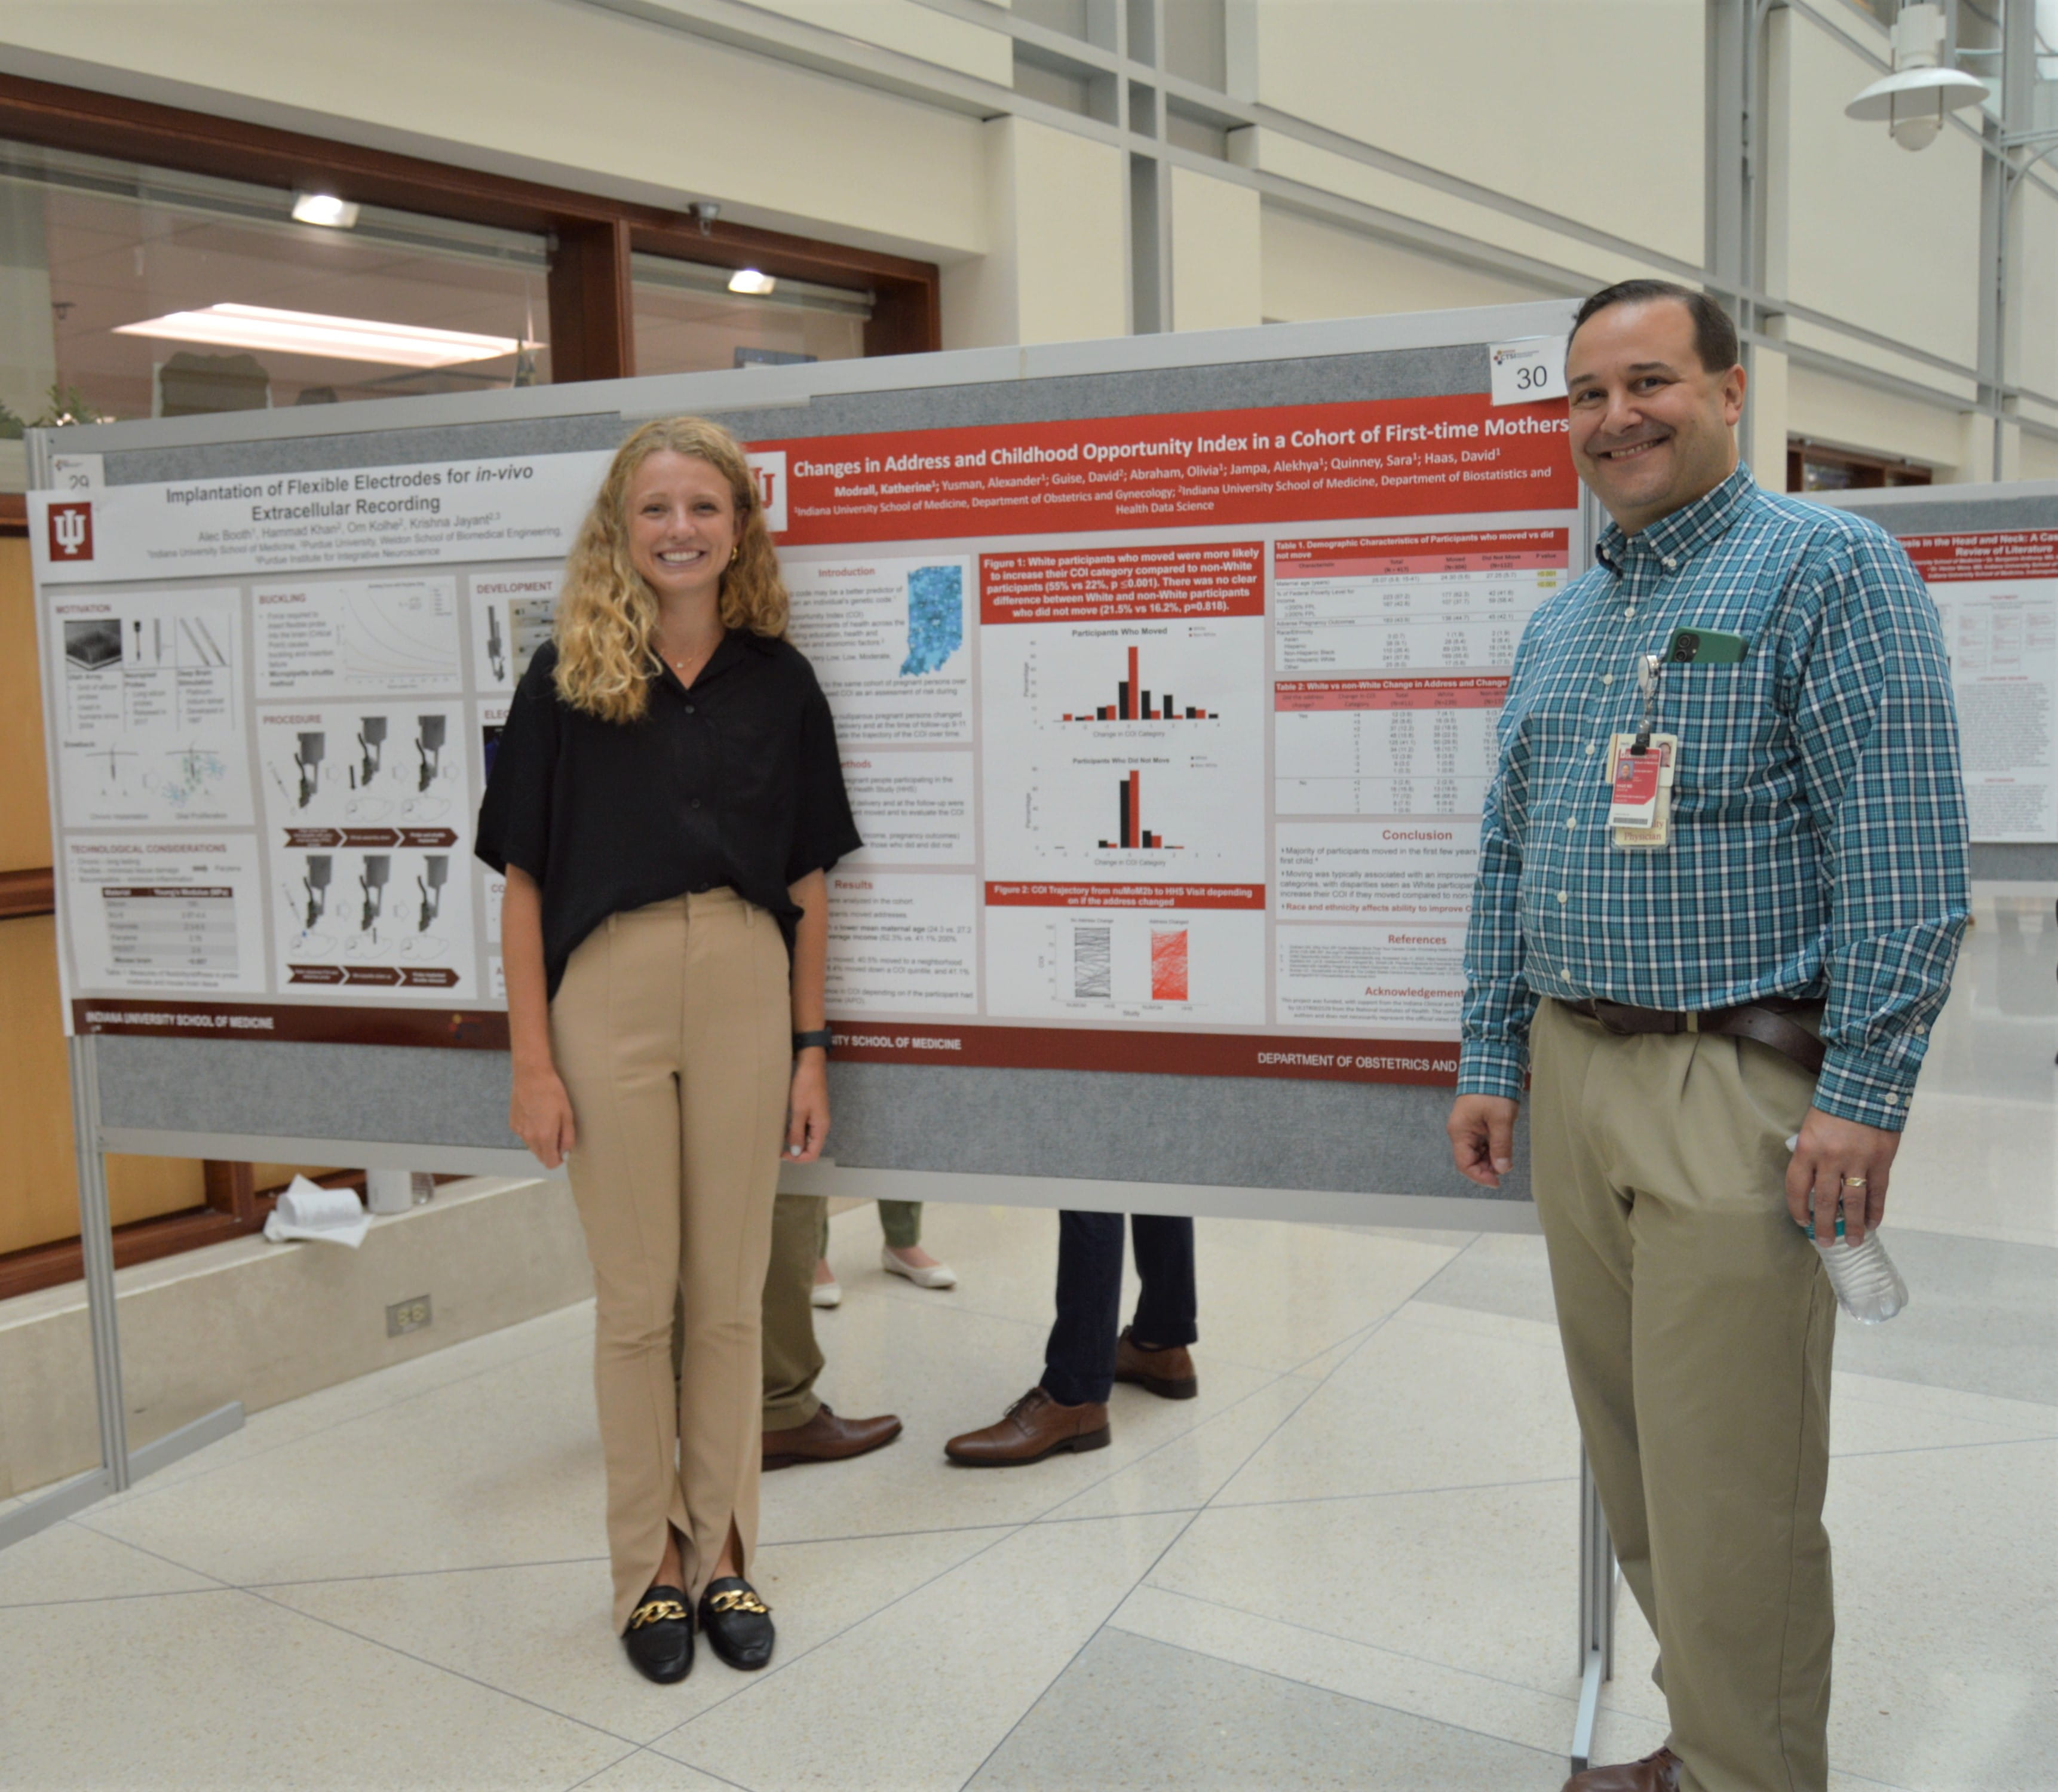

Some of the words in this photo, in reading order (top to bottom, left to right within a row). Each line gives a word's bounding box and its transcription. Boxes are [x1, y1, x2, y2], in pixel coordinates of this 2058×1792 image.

[1517, 366, 1547, 389] 30
[794, 461, 861, 478] Changes
[865, 457, 881, 472] in
[885, 455, 950, 471] Address
[955, 450, 986, 467] and
[990, 445, 1078, 465] Childhood
[1083, 440, 1192, 461] Opportunity
[1198, 435, 1247, 452] Index
[1253, 433, 1269, 449] in
[1275, 435, 1285, 449] a
[1291, 429, 1355, 447] Cohort
[1361, 425, 1381, 443] of
[1386, 422, 1479, 441] First-time
[1485, 416, 1572, 435] Mothers
[835, 484, 878, 497] Modrall,
[941, 480, 985, 490] Yusman,
[1051, 473, 1085, 484] Guise,
[1130, 468, 1184, 480] Abraham,
[1230, 464, 1270, 475] Jampa,
[1331, 458, 1383, 470] Quinney,
[1425, 453, 1457, 464] Haas,
[166, 486, 262, 504] Implantation
[268, 480, 283, 497] of
[288, 478, 349, 494] Flexible
[355, 472, 441, 490] Electrodes
[447, 468, 470, 484] for
[476, 465, 533, 481] in-vivo
[833, 504, 878, 515] University
[879, 502, 910, 513] School
[912, 500, 922, 511] of
[924, 499, 970, 510] Medicine,
[972, 496, 1029, 508] Department
[1031, 493, 1041, 504] of
[1043, 493, 1092, 503] Obstetrics
[1094, 490, 1113, 501] and
[1115, 489, 1175, 500] Gynecology;
[1222, 483, 1273, 493] University
[1276, 480, 1309, 491] School
[1312, 478, 1324, 489] of
[1326, 477, 1378, 488] Medicine,
[1381, 474, 1446, 486] Department
[1449, 471, 1460, 482] of
[1463, 470, 1528, 481] Biostatistics
[1531, 467, 1551, 478] and
[252, 502, 351, 521] Extracellular
[356, 496, 440, 514] Recording
[1116, 504, 1148, 514] Health
[1151, 502, 1174, 513] Data
[1176, 502, 1214, 511] Science
[1275, 541, 1296, 550] Table
[1307, 538, 1358, 548] Demographic
[1360, 536, 1419, 546] Characteristics
[1431, 535, 1478, 543] Participants
[1499, 532, 1527, 540] moved
[1955, 547, 1990, 557] Review
[1993, 546, 2003, 555] of
[2005, 545, 2053, 555] Literature
[984, 559, 1014, 570] Figure
[1017, 558, 1025, 567] 1:
[1028, 557, 1056, 566] White
[1058, 555, 1115, 566] participants
[1118, 554, 1139, 563] who
[1141, 552, 1174, 561] moved
[1177, 552, 1201, 560] were
[1203, 551, 1229, 559] more
[1232, 548, 1259, 559] likely
[818, 568, 875, 577] Introduction
[990, 572, 1001, 581] to
[1002, 572, 1044, 580] increase
[1045, 569, 1068, 578] their
[1070, 567, 1088, 578] COI
[1090, 567, 1133, 578] category
[1135, 564, 1185, 575] compared
[1187, 564, 1198, 572] to
[1200, 561, 1252, 572] non-White
[477, 582, 551, 594] DEVELOPMENT
[987, 584, 1043, 594] participants
[1163, 577, 1191, 586] There
[1193, 577, 1213, 585] was
[1231, 575, 1257, 584] clear
[259, 594, 306, 604] BUCKLING
[993, 596, 1041, 606] difference
[1043, 595, 1084, 603] between
[1085, 593, 1114, 602] White
[1116, 591, 1134, 601] and
[1137, 590, 1188, 600] non-White
[1190, 588, 1250, 599] participants
[56, 605, 111, 613] MOTIVATION
[1013, 608, 1033, 617] who
[1035, 607, 1051, 616] did
[1053, 607, 1069, 616] not
[1071, 607, 1098, 615] move
[1100, 604, 1133, 615] (21.5%
[1184, 601, 1229, 613] p=0.818).
[263, 714, 321, 724] PROCEDURE
[1382, 830, 1452, 840] Conclusion
[1624, 831, 1661, 842] Physician
[71, 845, 143, 854] TECHNOLOGICAL
[147, 844, 226, 853] CONSIDERATIONS
[833, 879, 872, 889] Results
[994, 885, 1020, 895] Figure
[1022, 885, 1029, 894] 2:
[1031, 885, 1047, 894] COI
[1048, 886, 1089, 898] Trajectory
[1091, 886, 1111, 896] from
[1165, 887, 1184, 896] HHS
[1186, 888, 1205, 896] Visit
[1207, 888, 1252, 898] depending
[1068, 898, 1079, 907] on
[1080, 897, 1087, 907] if
[1087, 897, 1102, 907] the
[1103, 898, 1136, 908] address
[1138, 898, 1174, 908] changed
[1392, 904, 1416, 913] ability
[1388, 934, 1446, 944] References
[1365, 987, 1466, 999] Acknowledgement
[85, 1011, 122, 1023] INDIANA
[124, 1013, 175, 1025] UNIVERSITY
[176, 1014, 214, 1027] SCHOOL
[215, 1015, 228, 1027] OF
[230, 1016, 274, 1029] MEDICINE
[851, 1036, 894, 1048] SCHOOL
[895, 1037, 909, 1048] OF
[912, 1038, 961, 1050] MEDICINE
[1258, 1053, 1334, 1066] DEPARTMENT
[1337, 1055, 1352, 1067] OF
[1355, 1057, 1430, 1070] OBSTETRICS
[1432, 1060, 1457, 1073] AND
